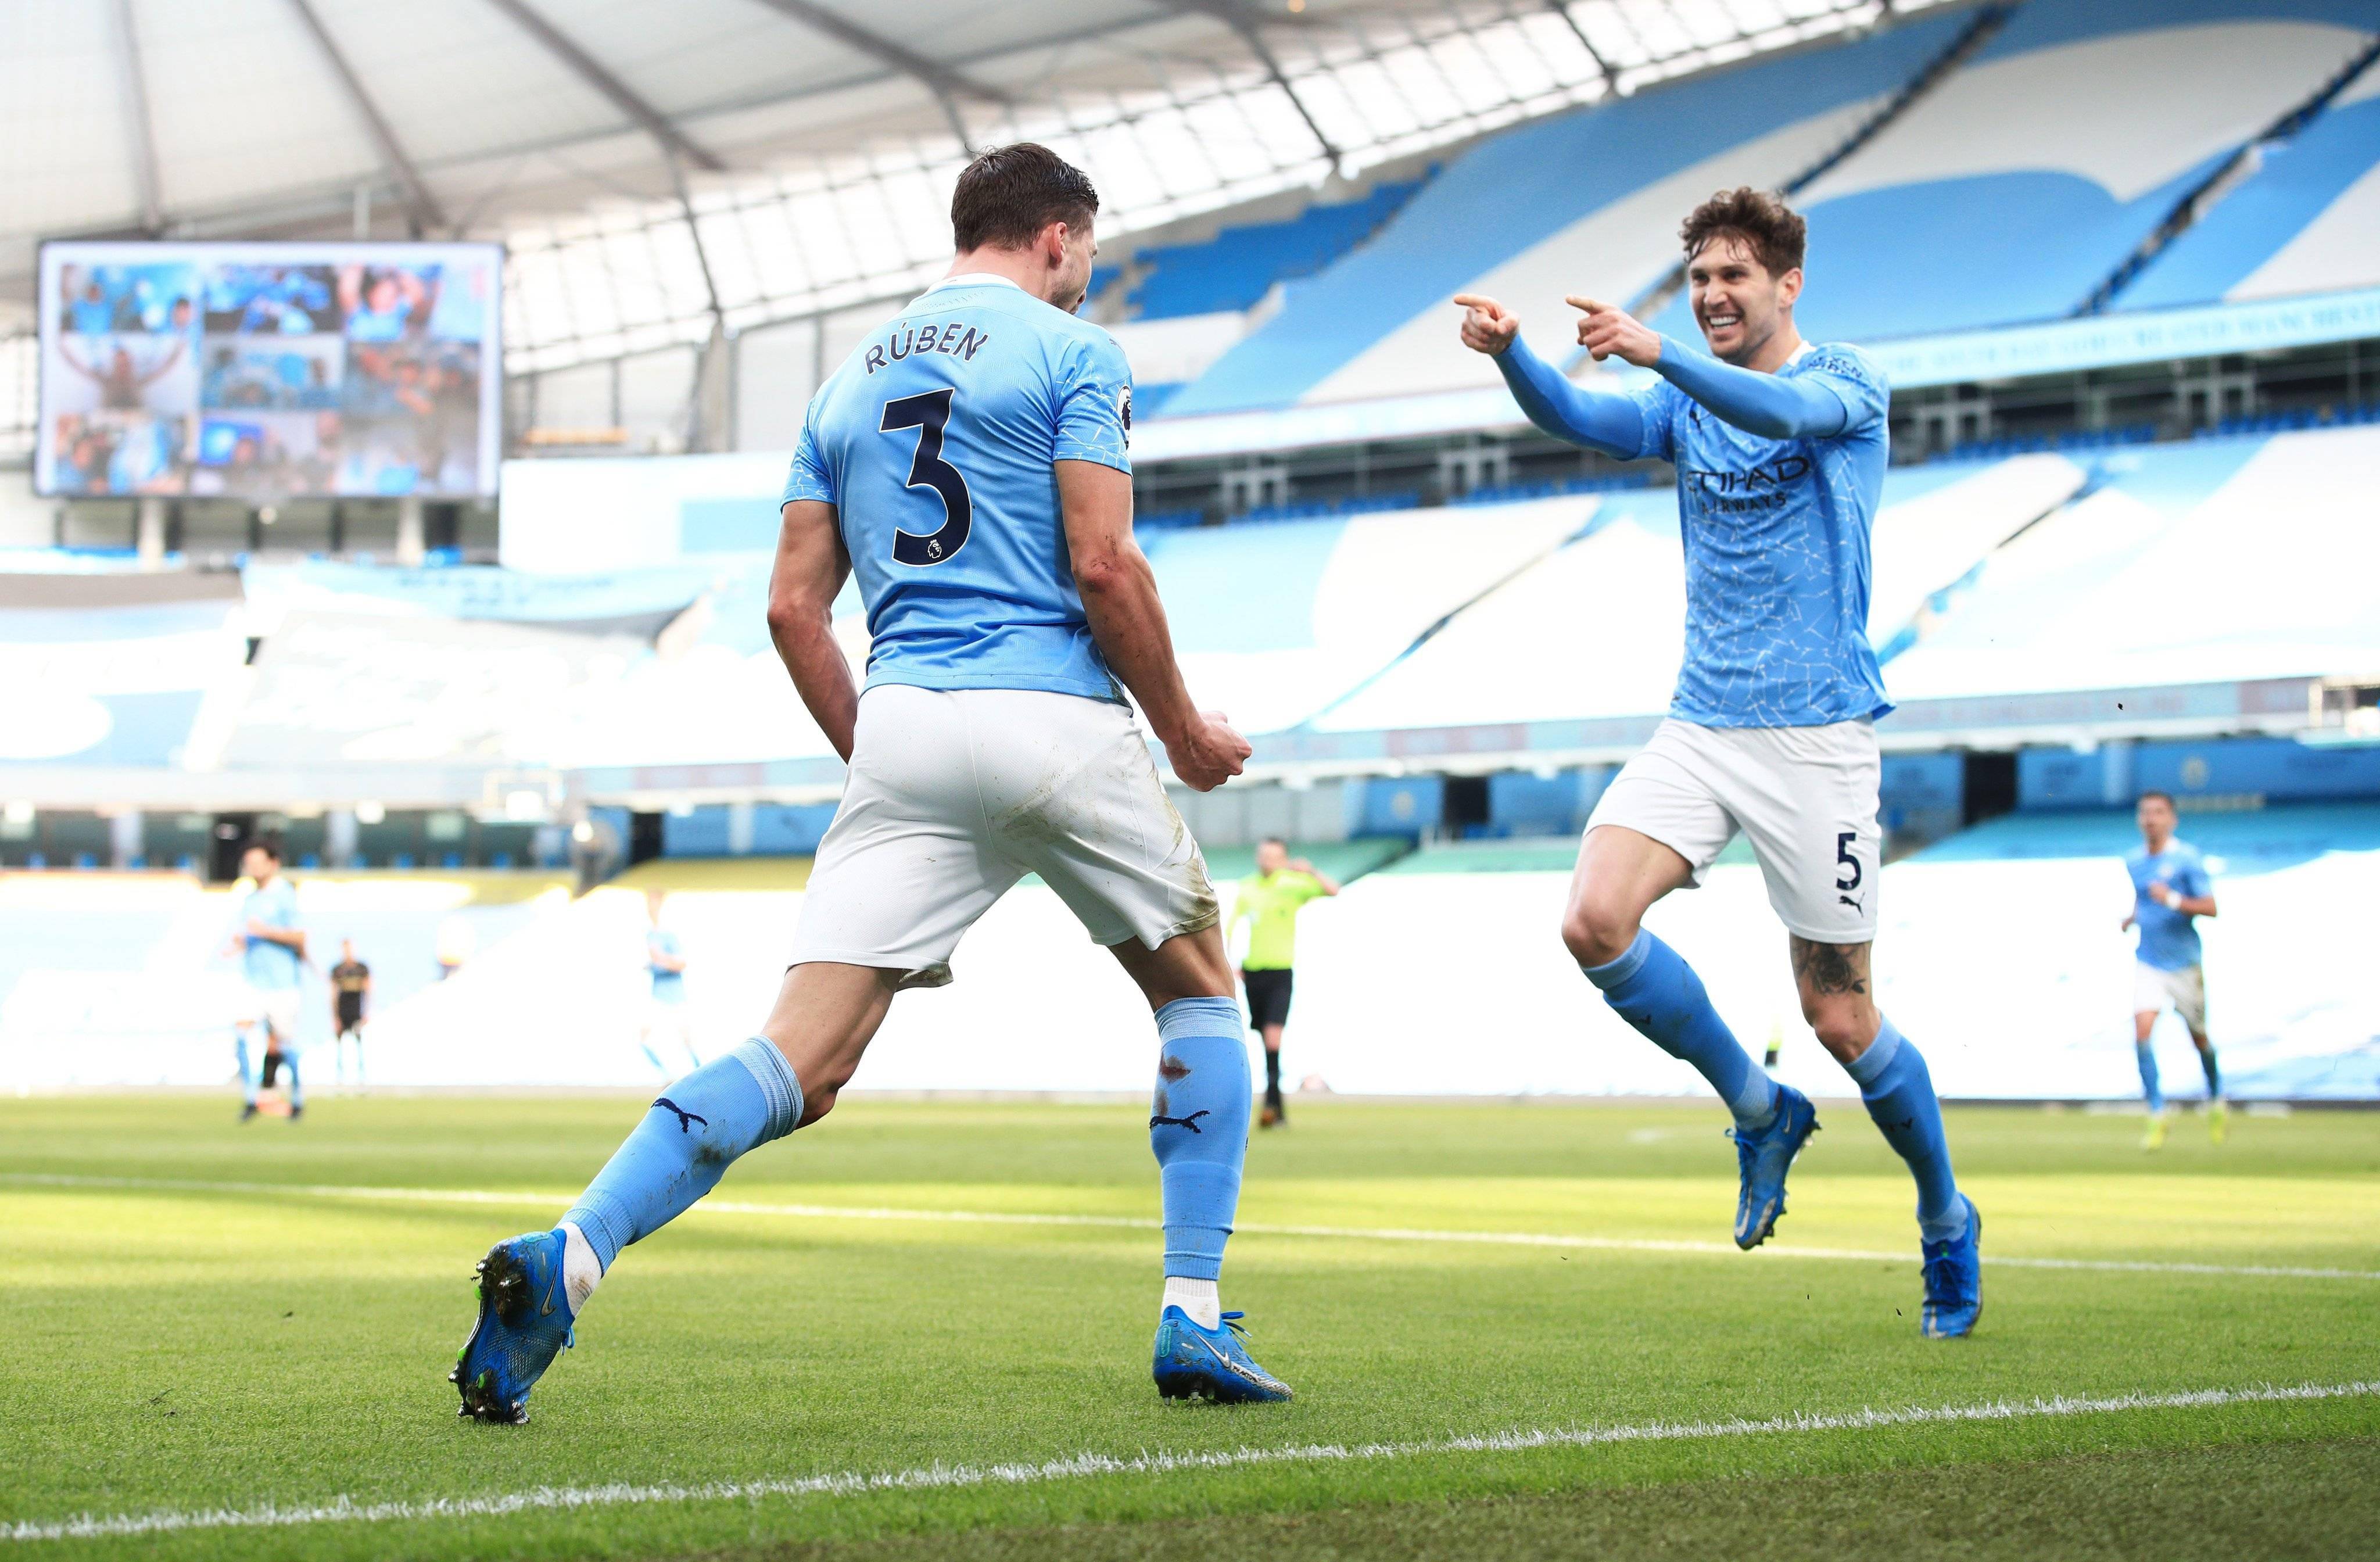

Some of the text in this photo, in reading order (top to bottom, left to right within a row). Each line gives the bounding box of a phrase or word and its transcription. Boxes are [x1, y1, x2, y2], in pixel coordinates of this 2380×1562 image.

[865, 321, 988, 376] RÚBEN
[879, 387, 972, 567] 3
[1837, 832, 1862, 891] 5
